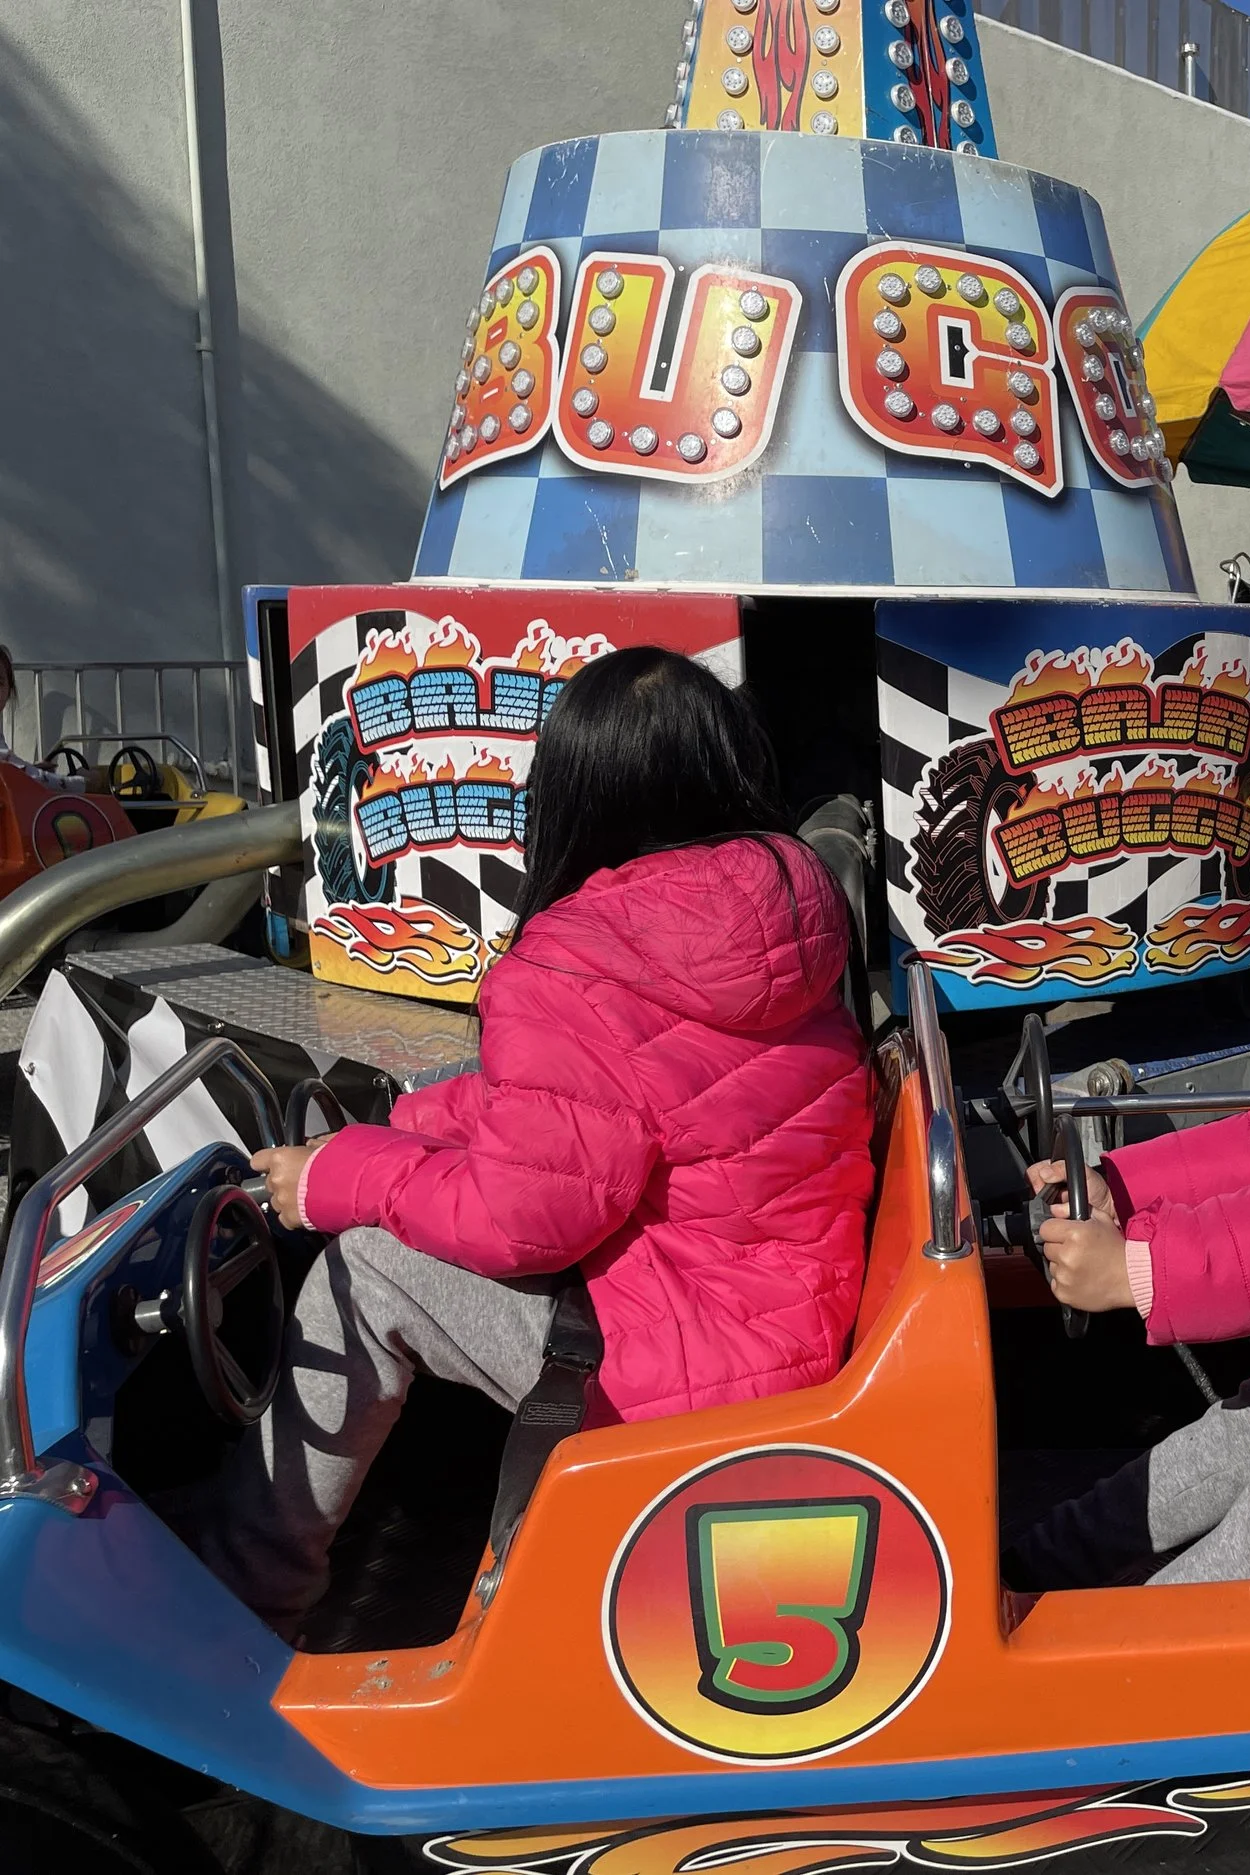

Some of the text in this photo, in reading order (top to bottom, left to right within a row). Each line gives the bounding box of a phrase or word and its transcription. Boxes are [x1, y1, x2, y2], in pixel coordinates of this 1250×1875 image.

[999, 684, 1250, 769] BAJA
[355, 779, 528, 863] BUG
[685, 1495, 881, 1716] 5
